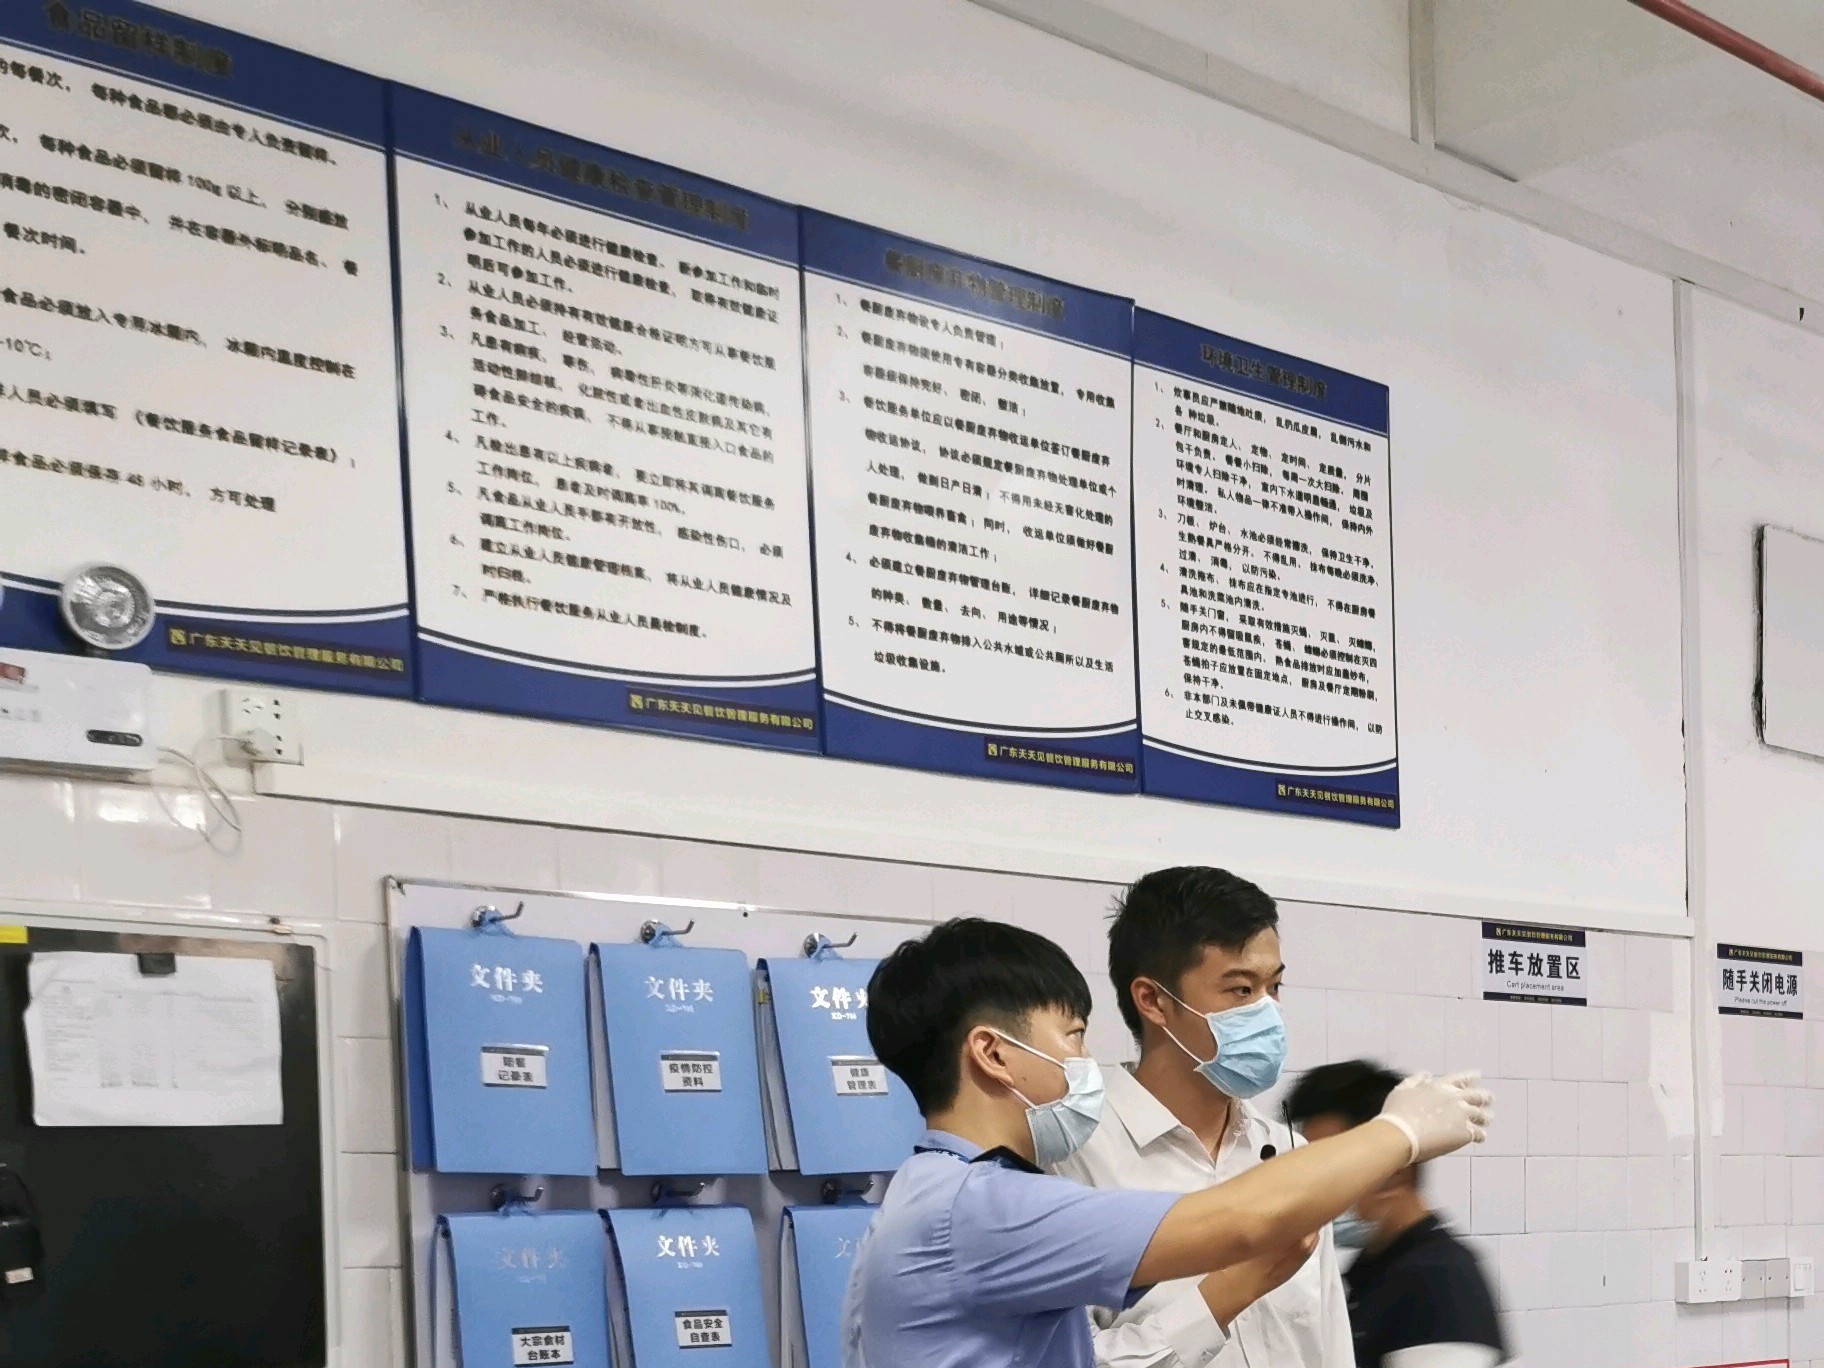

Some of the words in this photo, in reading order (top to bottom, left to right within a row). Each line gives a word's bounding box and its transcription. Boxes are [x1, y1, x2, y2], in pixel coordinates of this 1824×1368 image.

[1488, 948, 1581, 979] 推车放置区
[470, 963, 544, 994] 文件夹
[1506, 980, 1519, 989] Cart
[1520, 981, 1550, 991] placement
[1722, 968, 1798, 996] 随手关闭电源
[644, 976, 714, 1002] 文件夹
[668, 1063, 714, 1075] 疫情防控
[682, 1076, 704, 1088] 资料
[657, 1235, 721, 1258] 文件夹
[682, 1318, 724, 1330] 食品安全
[520, 1334, 565, 1348] 大宗食材
